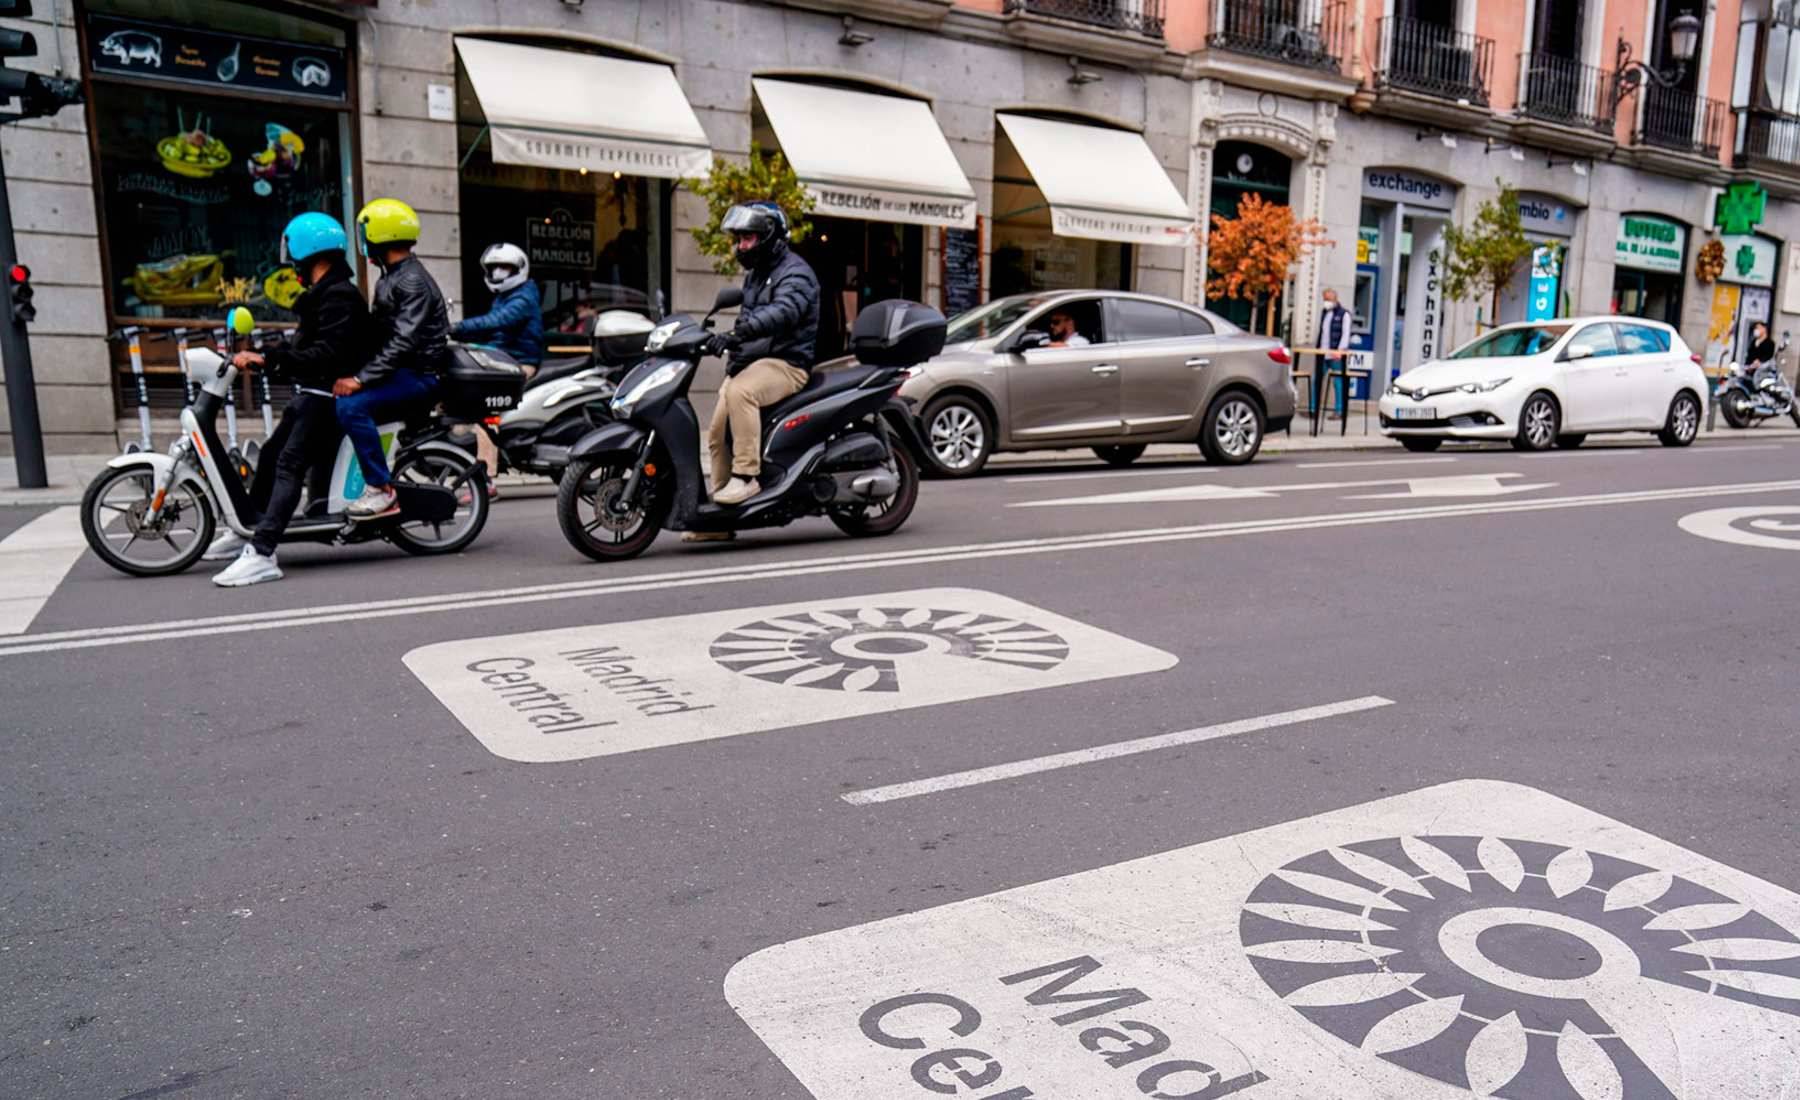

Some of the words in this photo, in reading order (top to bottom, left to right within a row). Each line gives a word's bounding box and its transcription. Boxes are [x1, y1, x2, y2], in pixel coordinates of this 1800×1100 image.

[525, 140, 590, 160] GOURMET
[600, 148, 680, 169] EXPERIENCE
[1369, 172, 1441, 199] exchange
[821, 190, 881, 211] REBELIÓN
[908, 201, 965, 220] MANDILES
[1518, 201, 1549, 220] mbio
[531, 223, 592, 240] REBELIÓN
[531, 247, 592, 265] MANDILES
[1422, 249, 1439, 360] exchang
[485, 395, 512, 408] 1199
[466, 657, 619, 734] Central
[558, 646, 715, 717] Madrid
